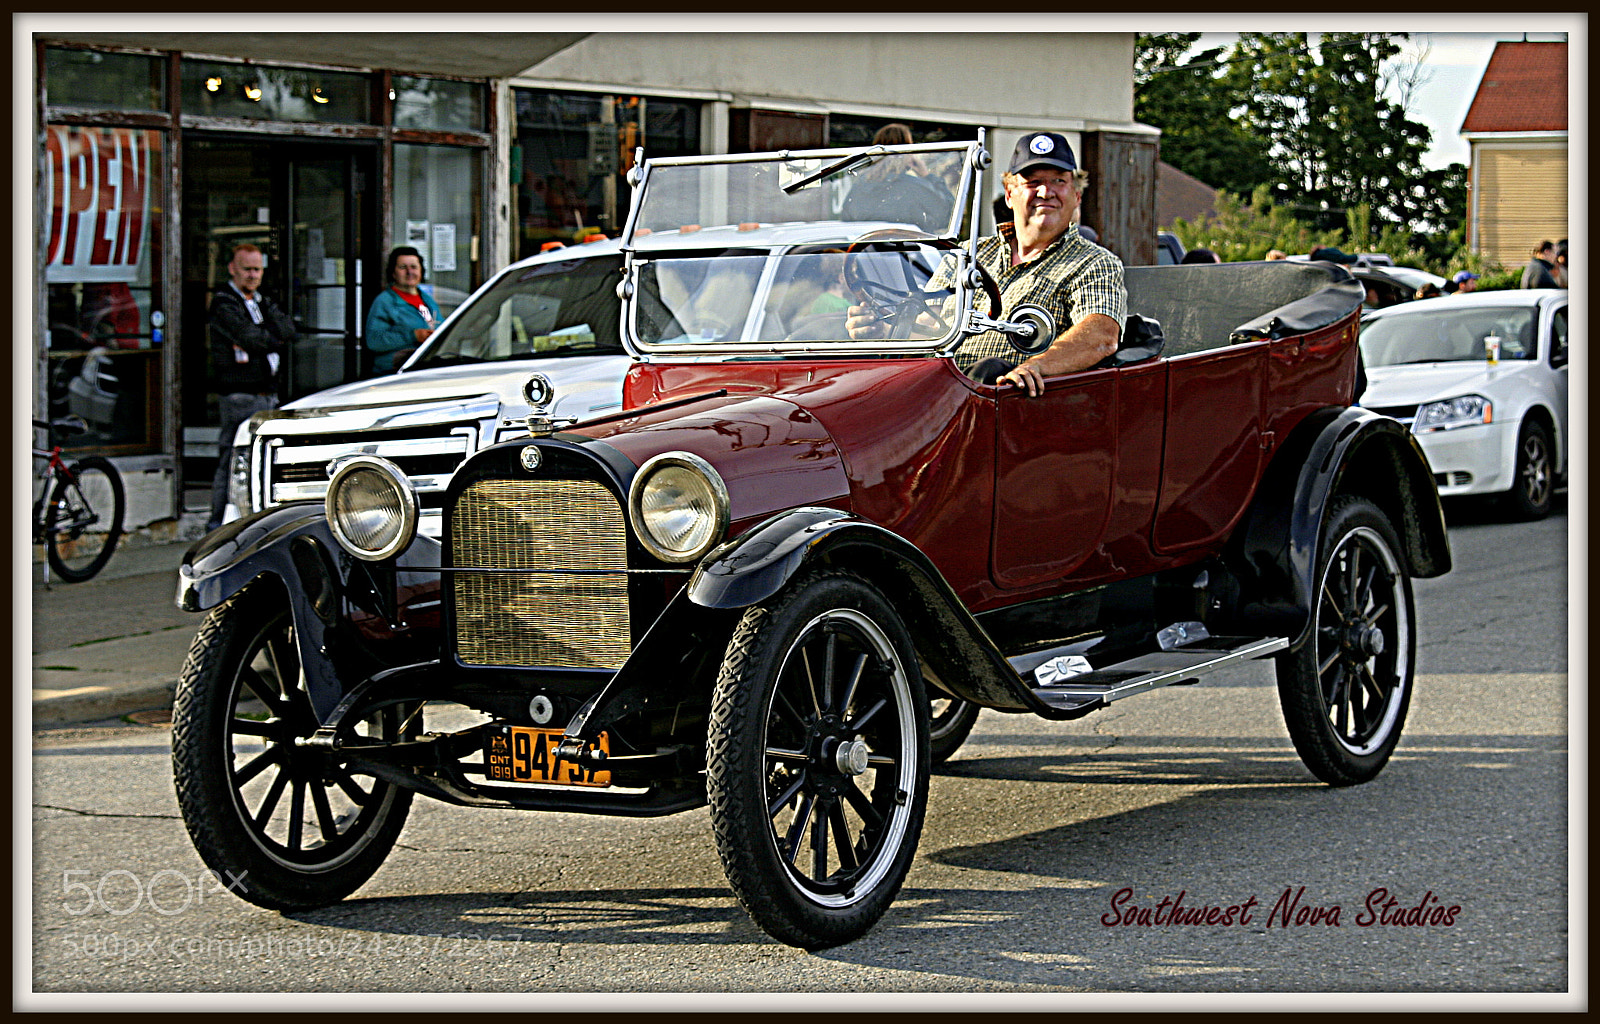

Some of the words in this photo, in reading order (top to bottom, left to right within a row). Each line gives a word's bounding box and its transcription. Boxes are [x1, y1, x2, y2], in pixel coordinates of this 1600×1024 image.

[46, 128, 147, 266] OPEN
[489, 754, 511, 765] ONT
[490, 765, 511, 779] 1919
